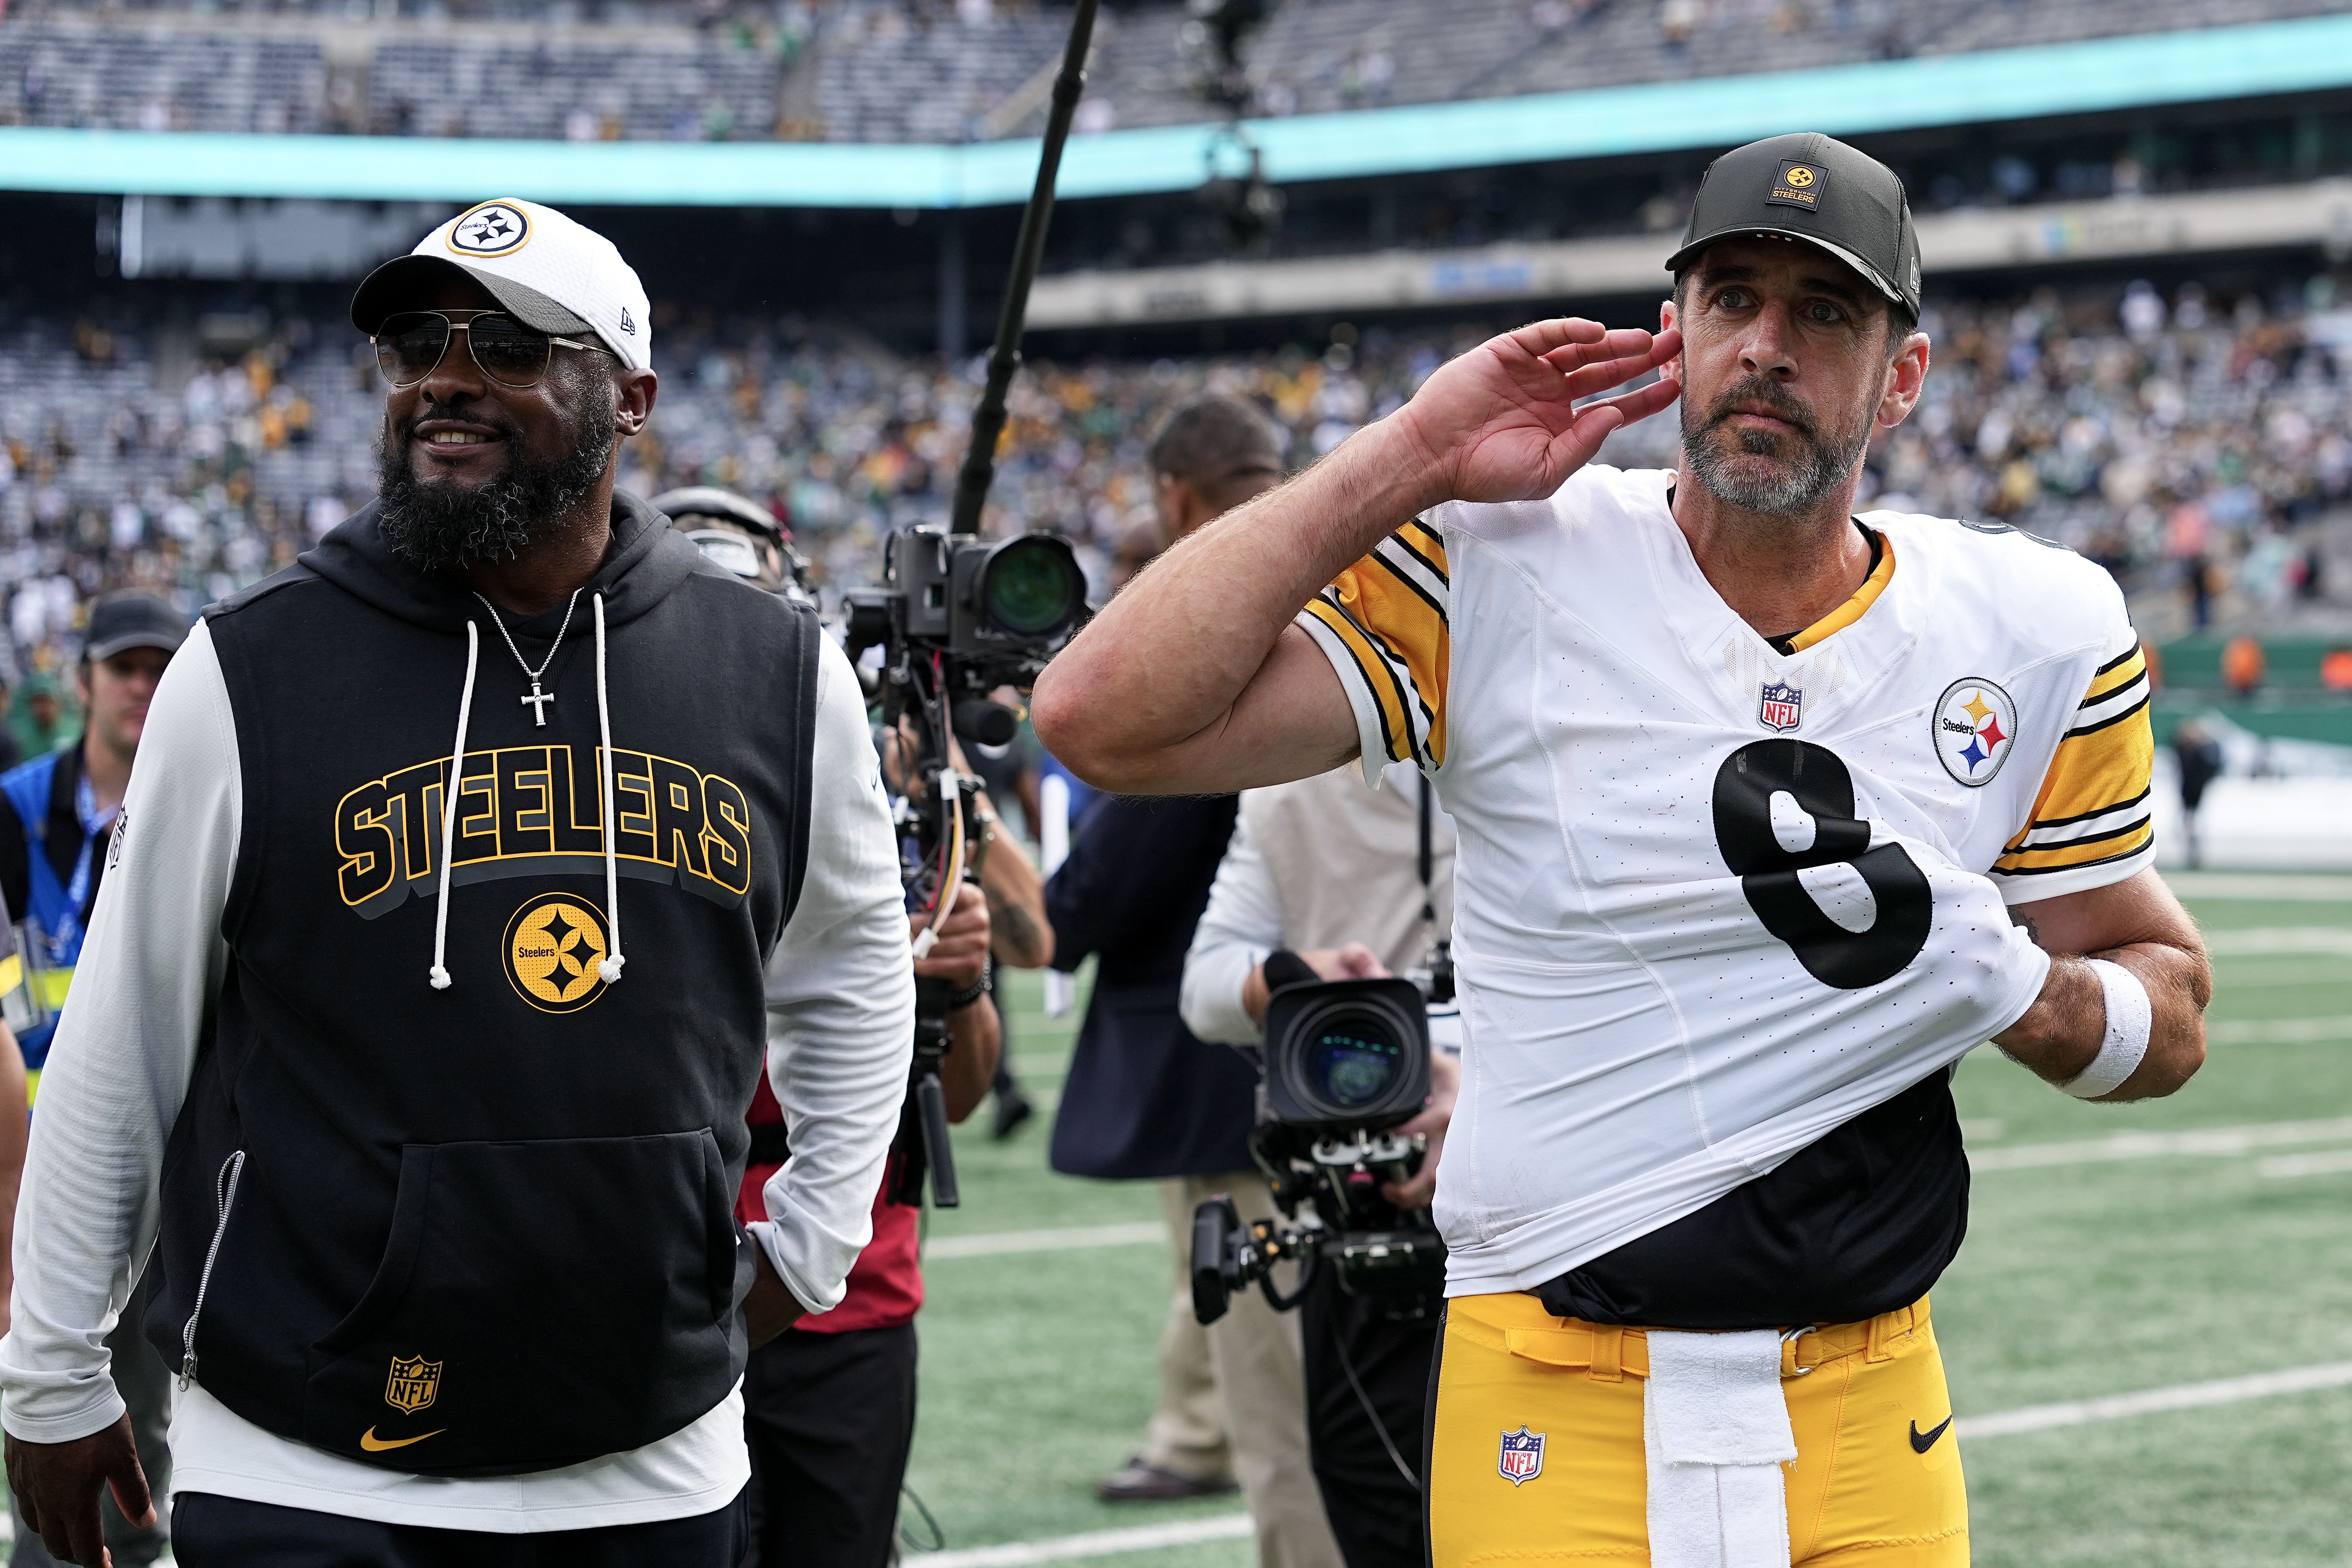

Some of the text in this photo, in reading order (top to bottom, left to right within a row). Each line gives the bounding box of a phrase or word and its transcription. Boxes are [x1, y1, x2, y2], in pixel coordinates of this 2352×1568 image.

[1773, 190, 1814, 203] STEELERS
[1775, 187, 1816, 197] PITTSBURGH
[1764, 702, 1796, 725] NFL
[1942, 717, 1975, 736] Steelers
[335, 745, 751, 906] STEELERS
[1712, 738, 1933, 990] 8
[518, 946, 555, 959] Steelers
[391, 1380, 430, 1405] NFL
[1504, 1452, 1534, 1474] NFL
